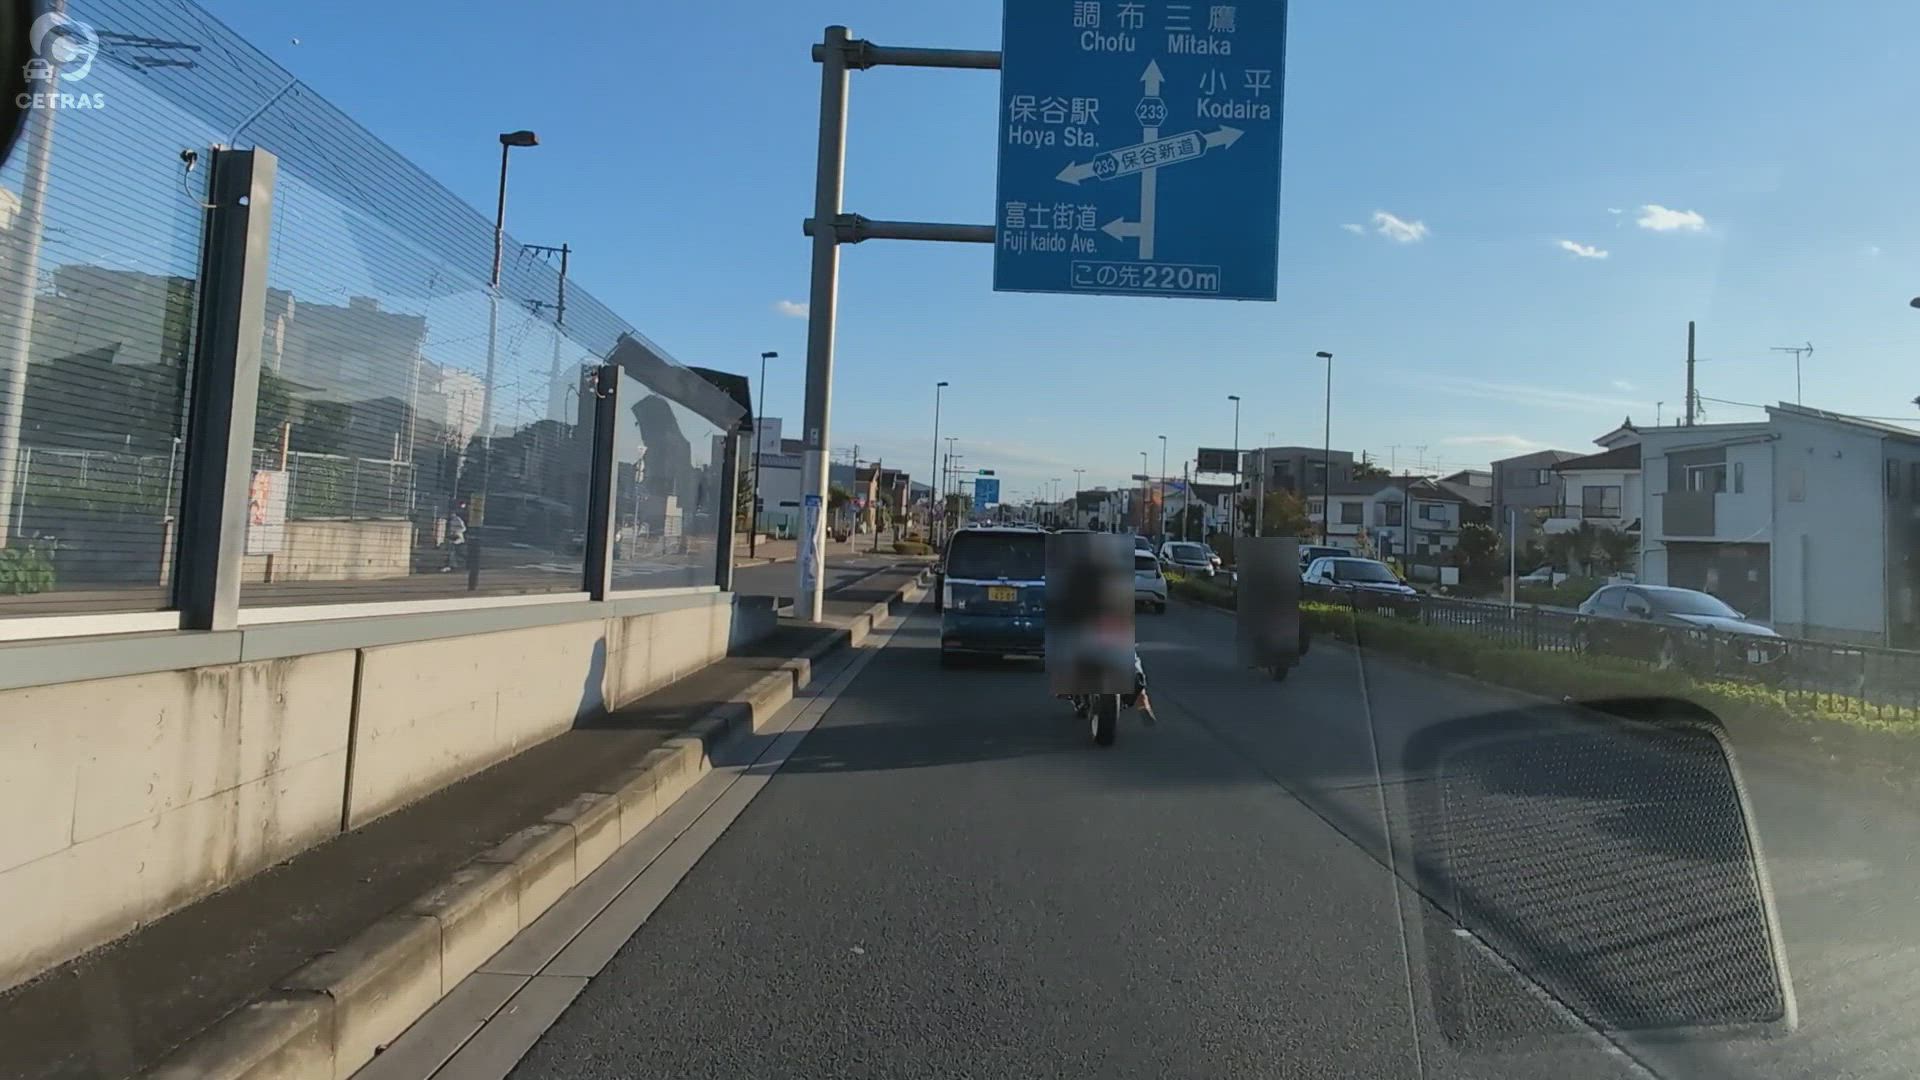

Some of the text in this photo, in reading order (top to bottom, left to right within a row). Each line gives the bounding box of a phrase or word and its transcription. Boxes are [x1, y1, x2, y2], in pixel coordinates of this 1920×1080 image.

[1073, 1, 1145, 29] 調布
[1164, 5, 1236, 33] 三鷹
[1080, 31, 1136, 51] Chofu
[1167, 34, 1231, 55] Mitaka
[1199, 68, 1272, 97] 小平
[1008, 95, 1100, 125] 保谷駅
[1138, 105, 1164, 119] 233
[1197, 98, 1271, 120] Kodaira
[1008, 125, 1099, 149] Hoya Sta.
[1095, 158, 1116, 175] 233
[1121, 138, 1195, 170] 保谷新道
[1005, 200, 1097, 231] 富士街道
[1003, 230, 1097, 255] Fuji kaido Ave.
[1074, 264, 1217, 290] この先220m
